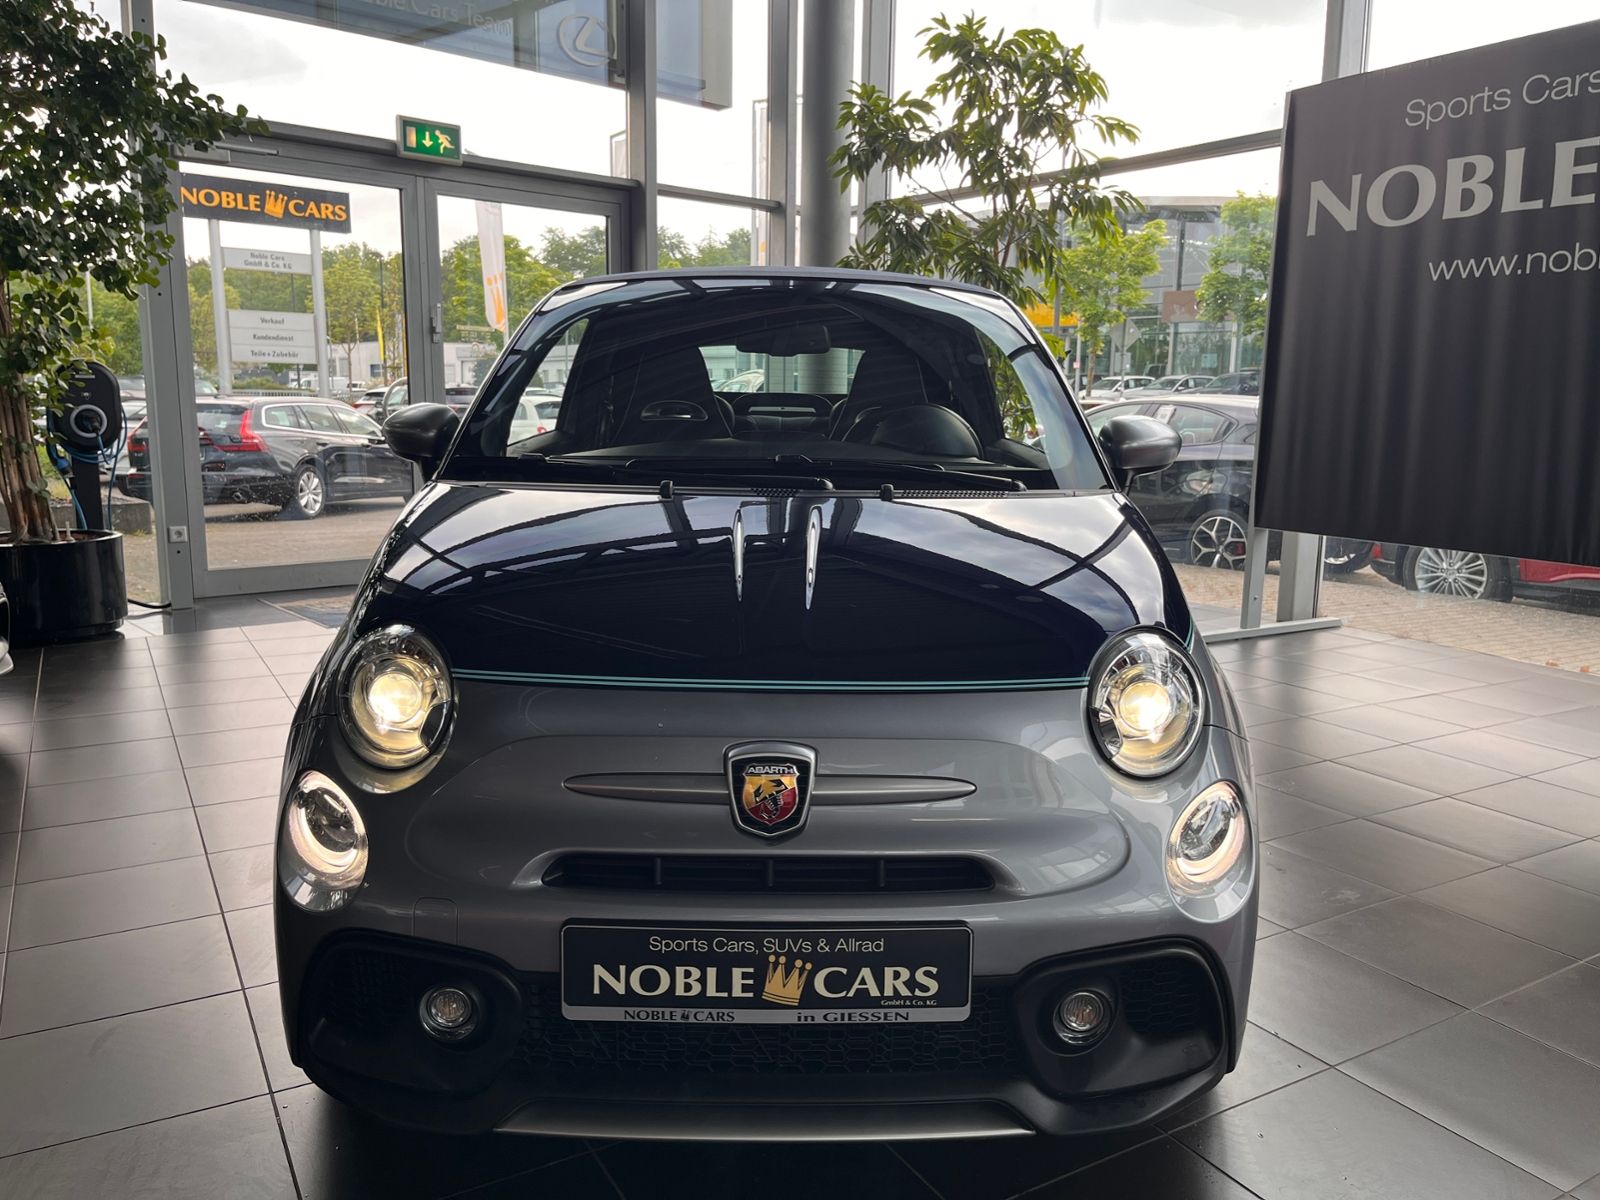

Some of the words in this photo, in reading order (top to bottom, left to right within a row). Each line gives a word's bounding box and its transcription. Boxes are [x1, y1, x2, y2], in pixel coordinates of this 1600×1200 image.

[464, 2, 513, 36] Team
[1404, 86, 1511, 130] Sports
[1522, 69, 1600, 104] Cars
[1306, 136, 1600, 237] NOBLE
[180, 186, 261, 212] NOBLE
[288, 199, 348, 222] CARS
[250, 252, 268, 260] Noble
[1428, 242, 1600, 282] www.nob
[260, 317, 285, 325] Verkauf
[252, 333, 294, 342] Kundendienst
[747, 766, 794, 774] ABARTH
[649, 936, 708, 954] Sports
[713, 937, 759, 954] Cars,
[763, 938, 812, 953] SUVs
[816, 938, 831, 952] &
[835, 938, 884, 952] Allrad
[592, 964, 755, 998] NOBLE
[813, 966, 939, 998] CARS
[624, 1009, 677, 1021] NOBLE
[693, 1011, 735, 1022] CARS
[797, 1012, 815, 1022] in
[823, 1011, 909, 1022] GIESSEN
